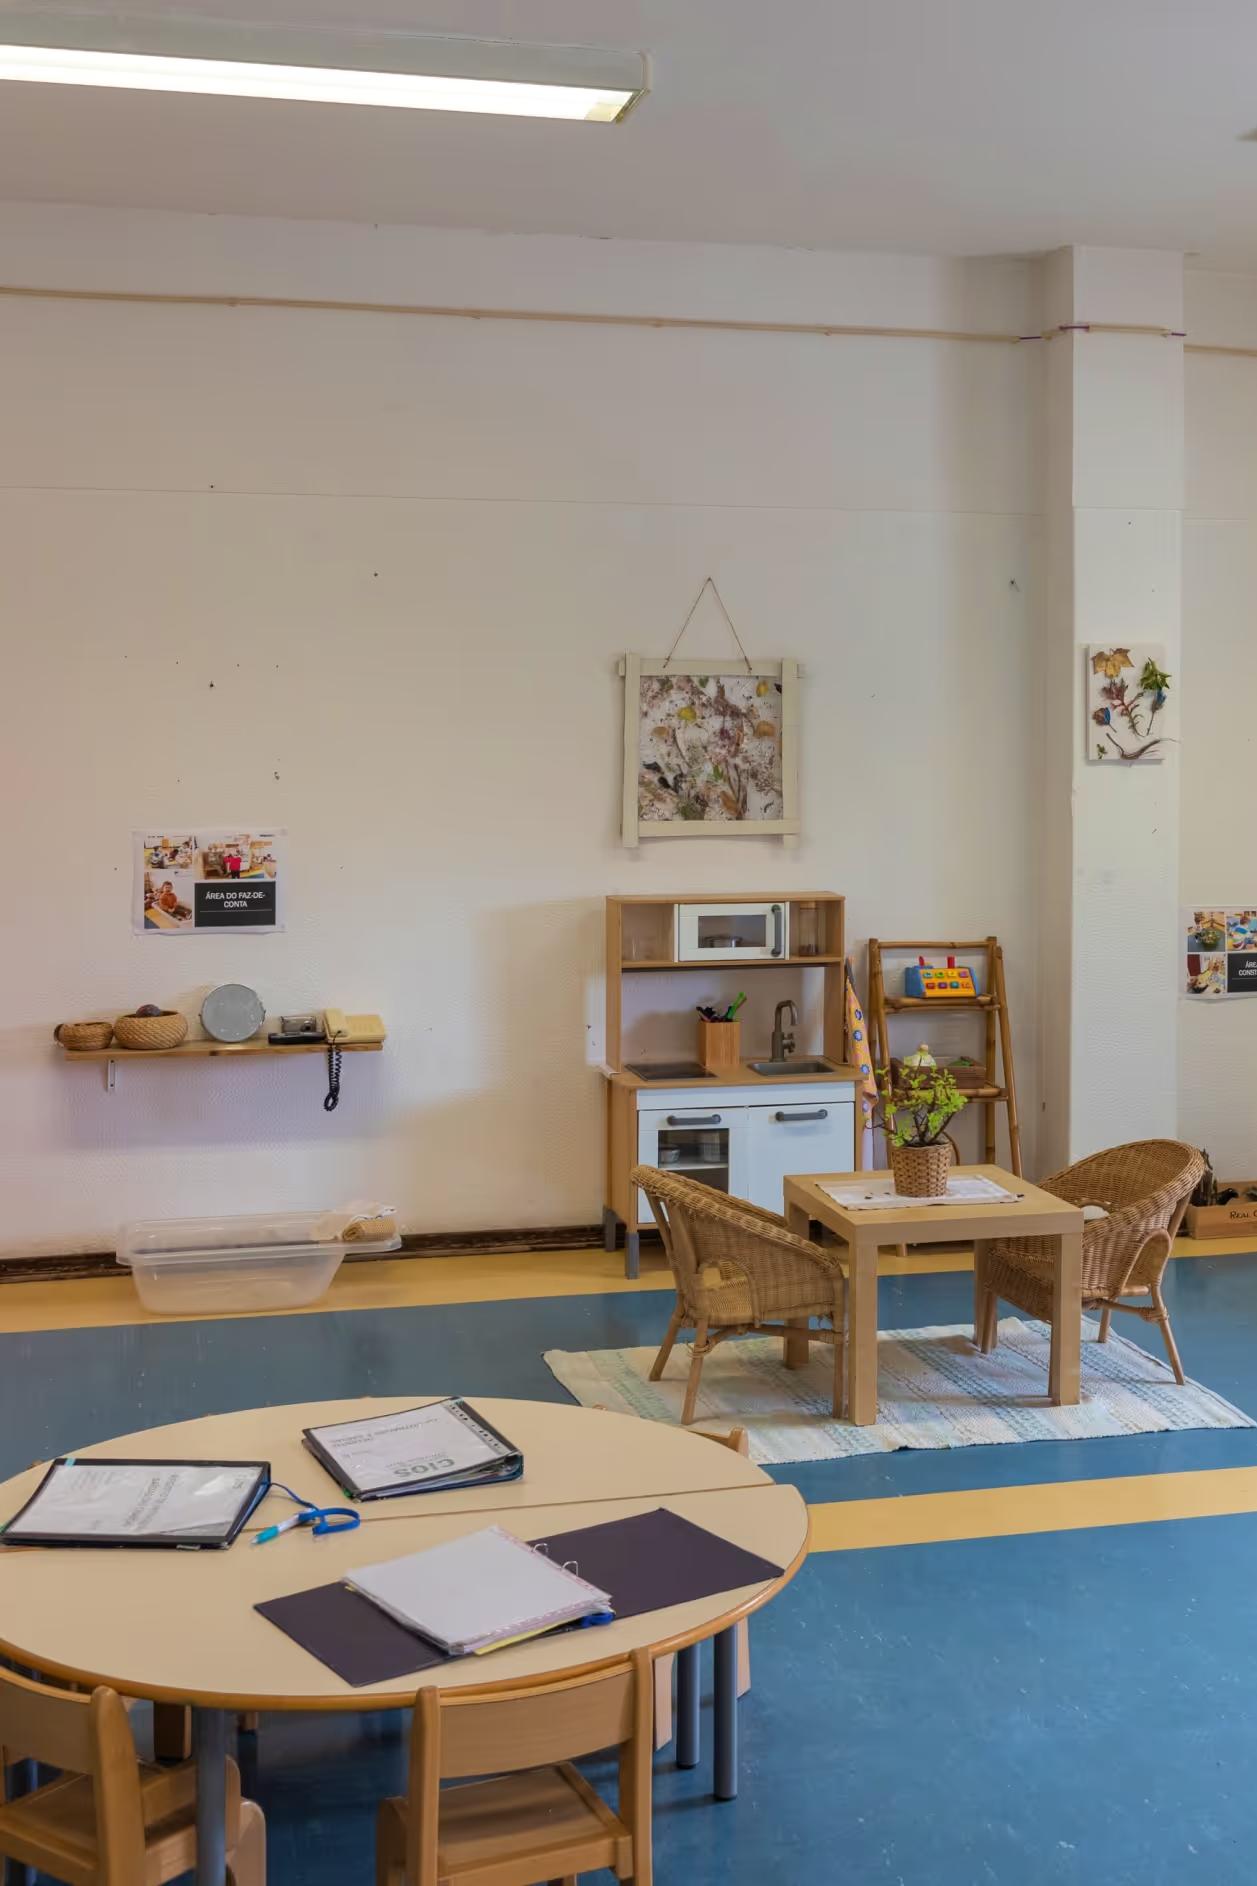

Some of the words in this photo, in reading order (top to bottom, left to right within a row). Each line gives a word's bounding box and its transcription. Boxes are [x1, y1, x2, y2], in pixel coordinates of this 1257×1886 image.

[205, 891, 225, 900] ÁREA
[238, 891, 266, 899] FAZ-DE-
[223, 900, 248, 908] CONTA
